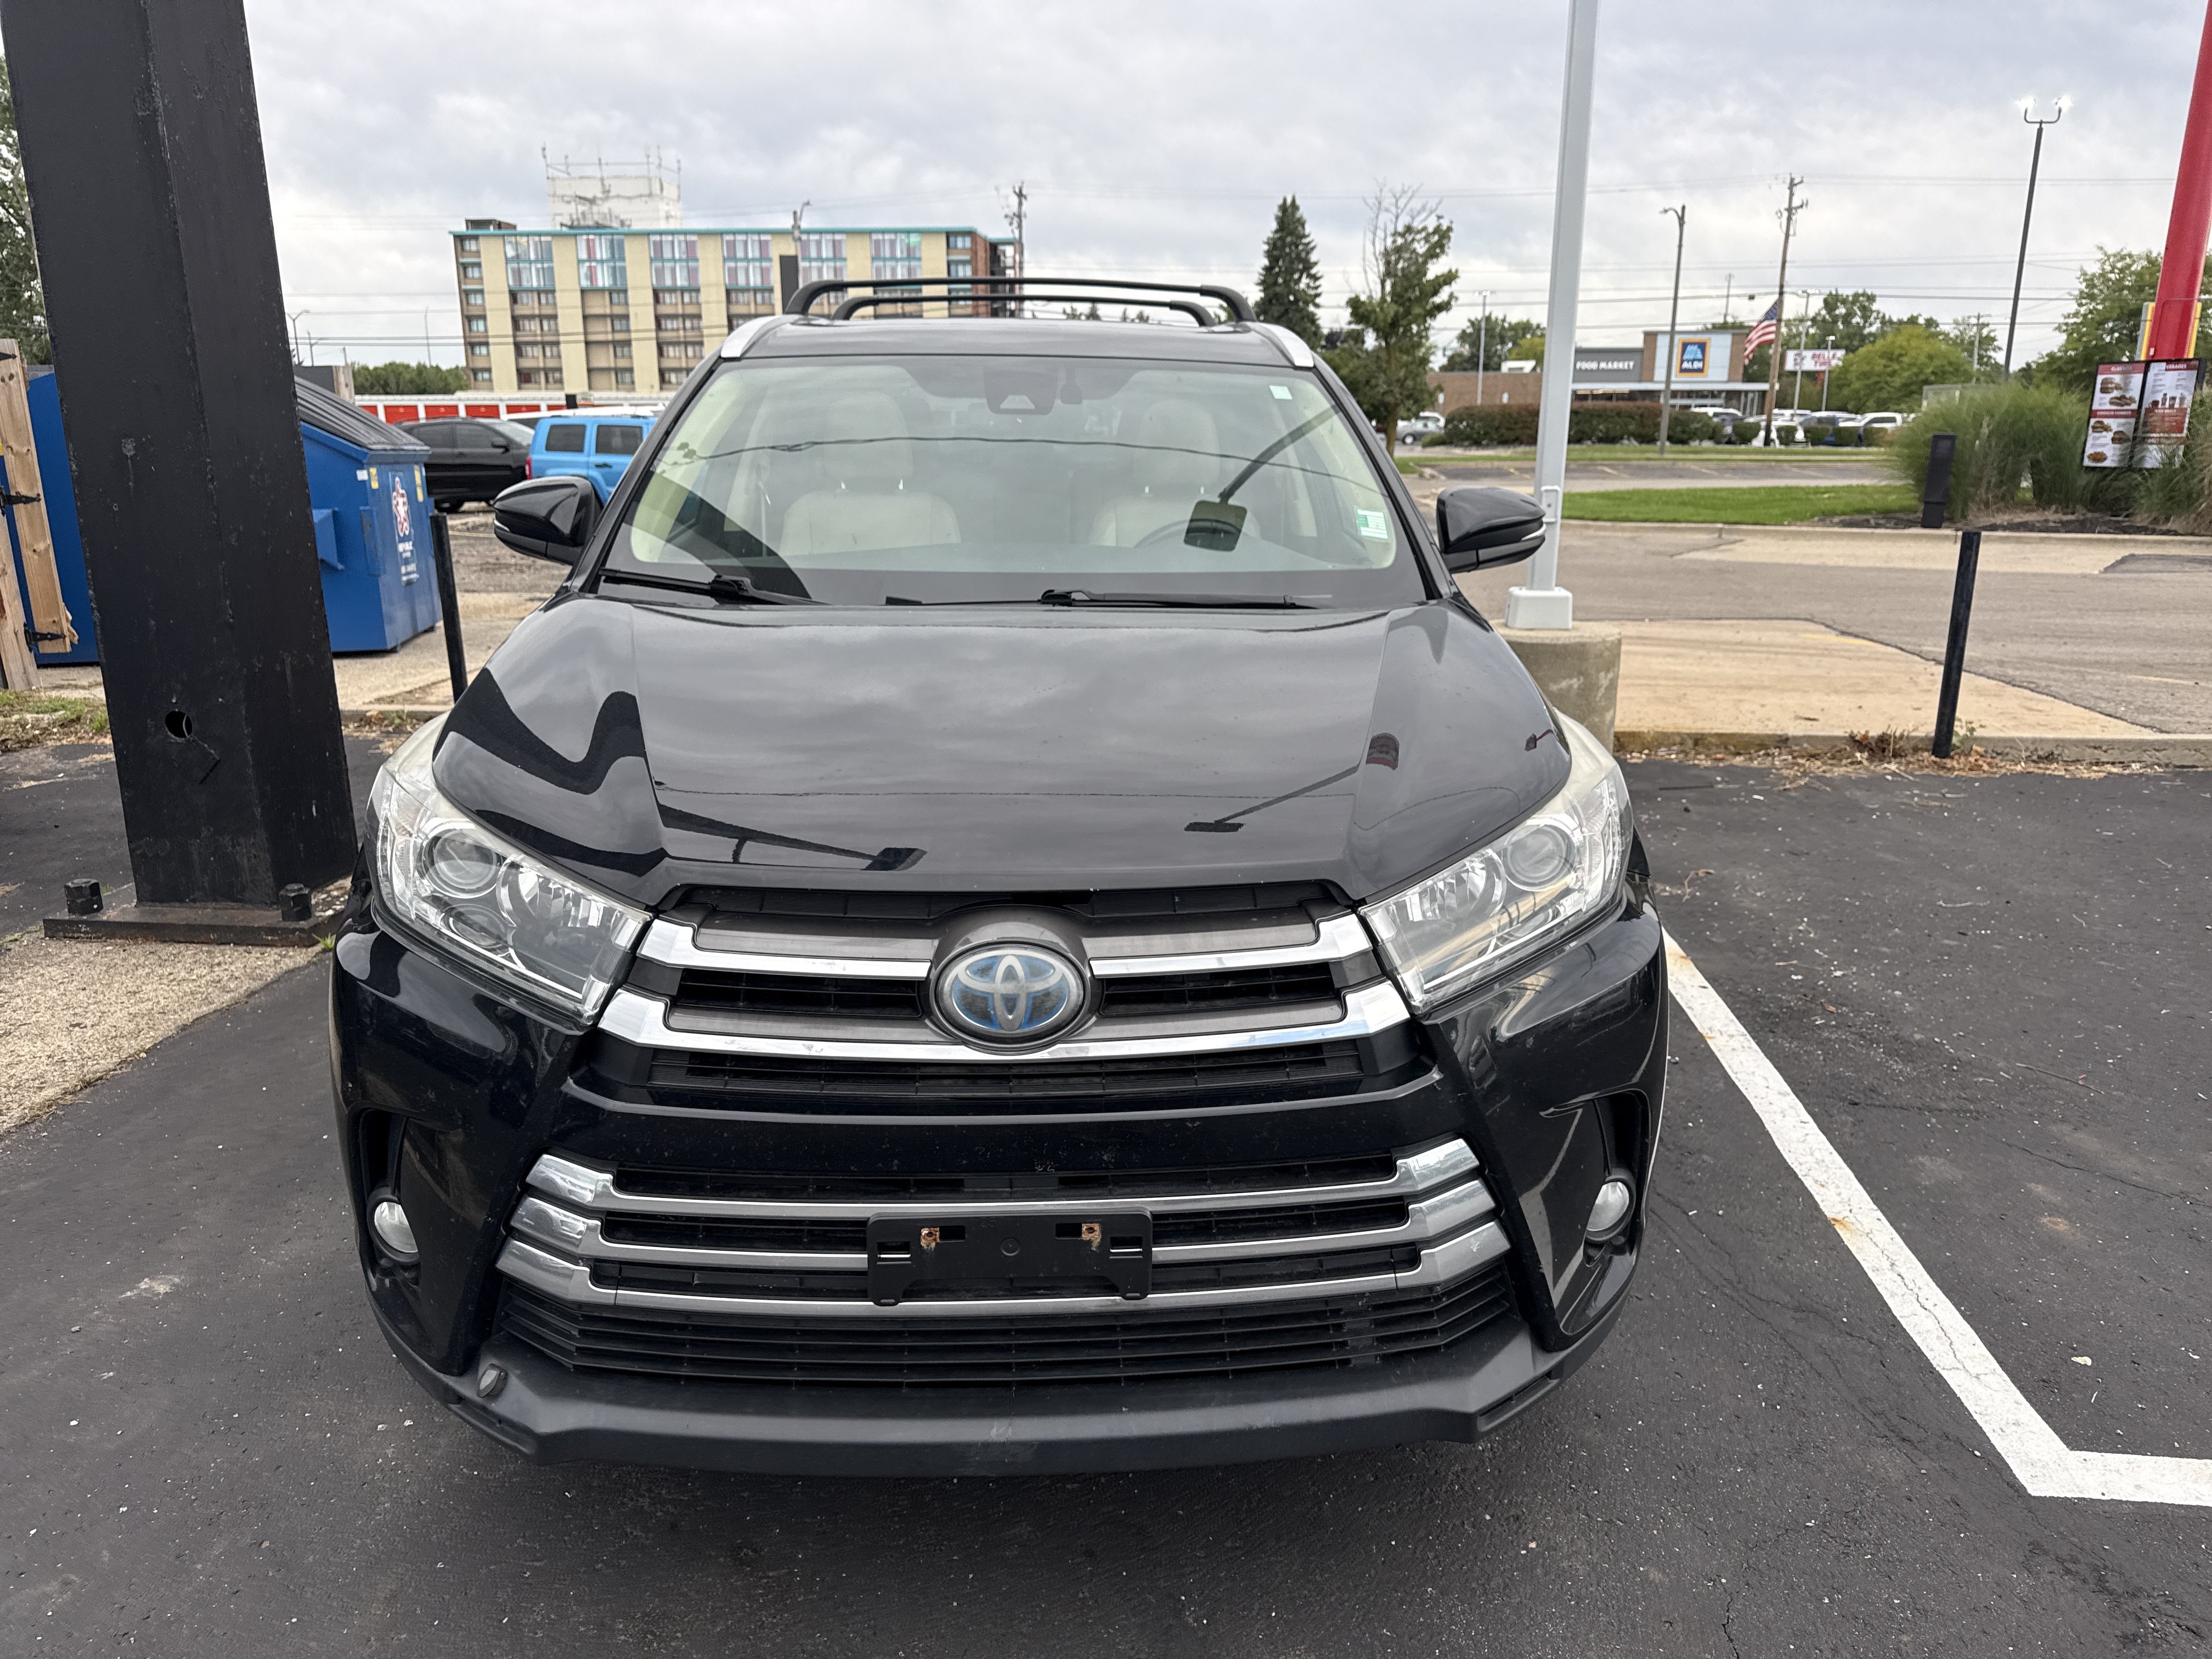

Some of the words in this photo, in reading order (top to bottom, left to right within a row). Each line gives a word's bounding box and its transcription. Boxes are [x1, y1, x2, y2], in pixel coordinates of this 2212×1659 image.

[1576, 361, 1598, 370] FOOD
[1599, 361, 1634, 370] MARKET
[1681, 360, 1703, 369] ALDI
